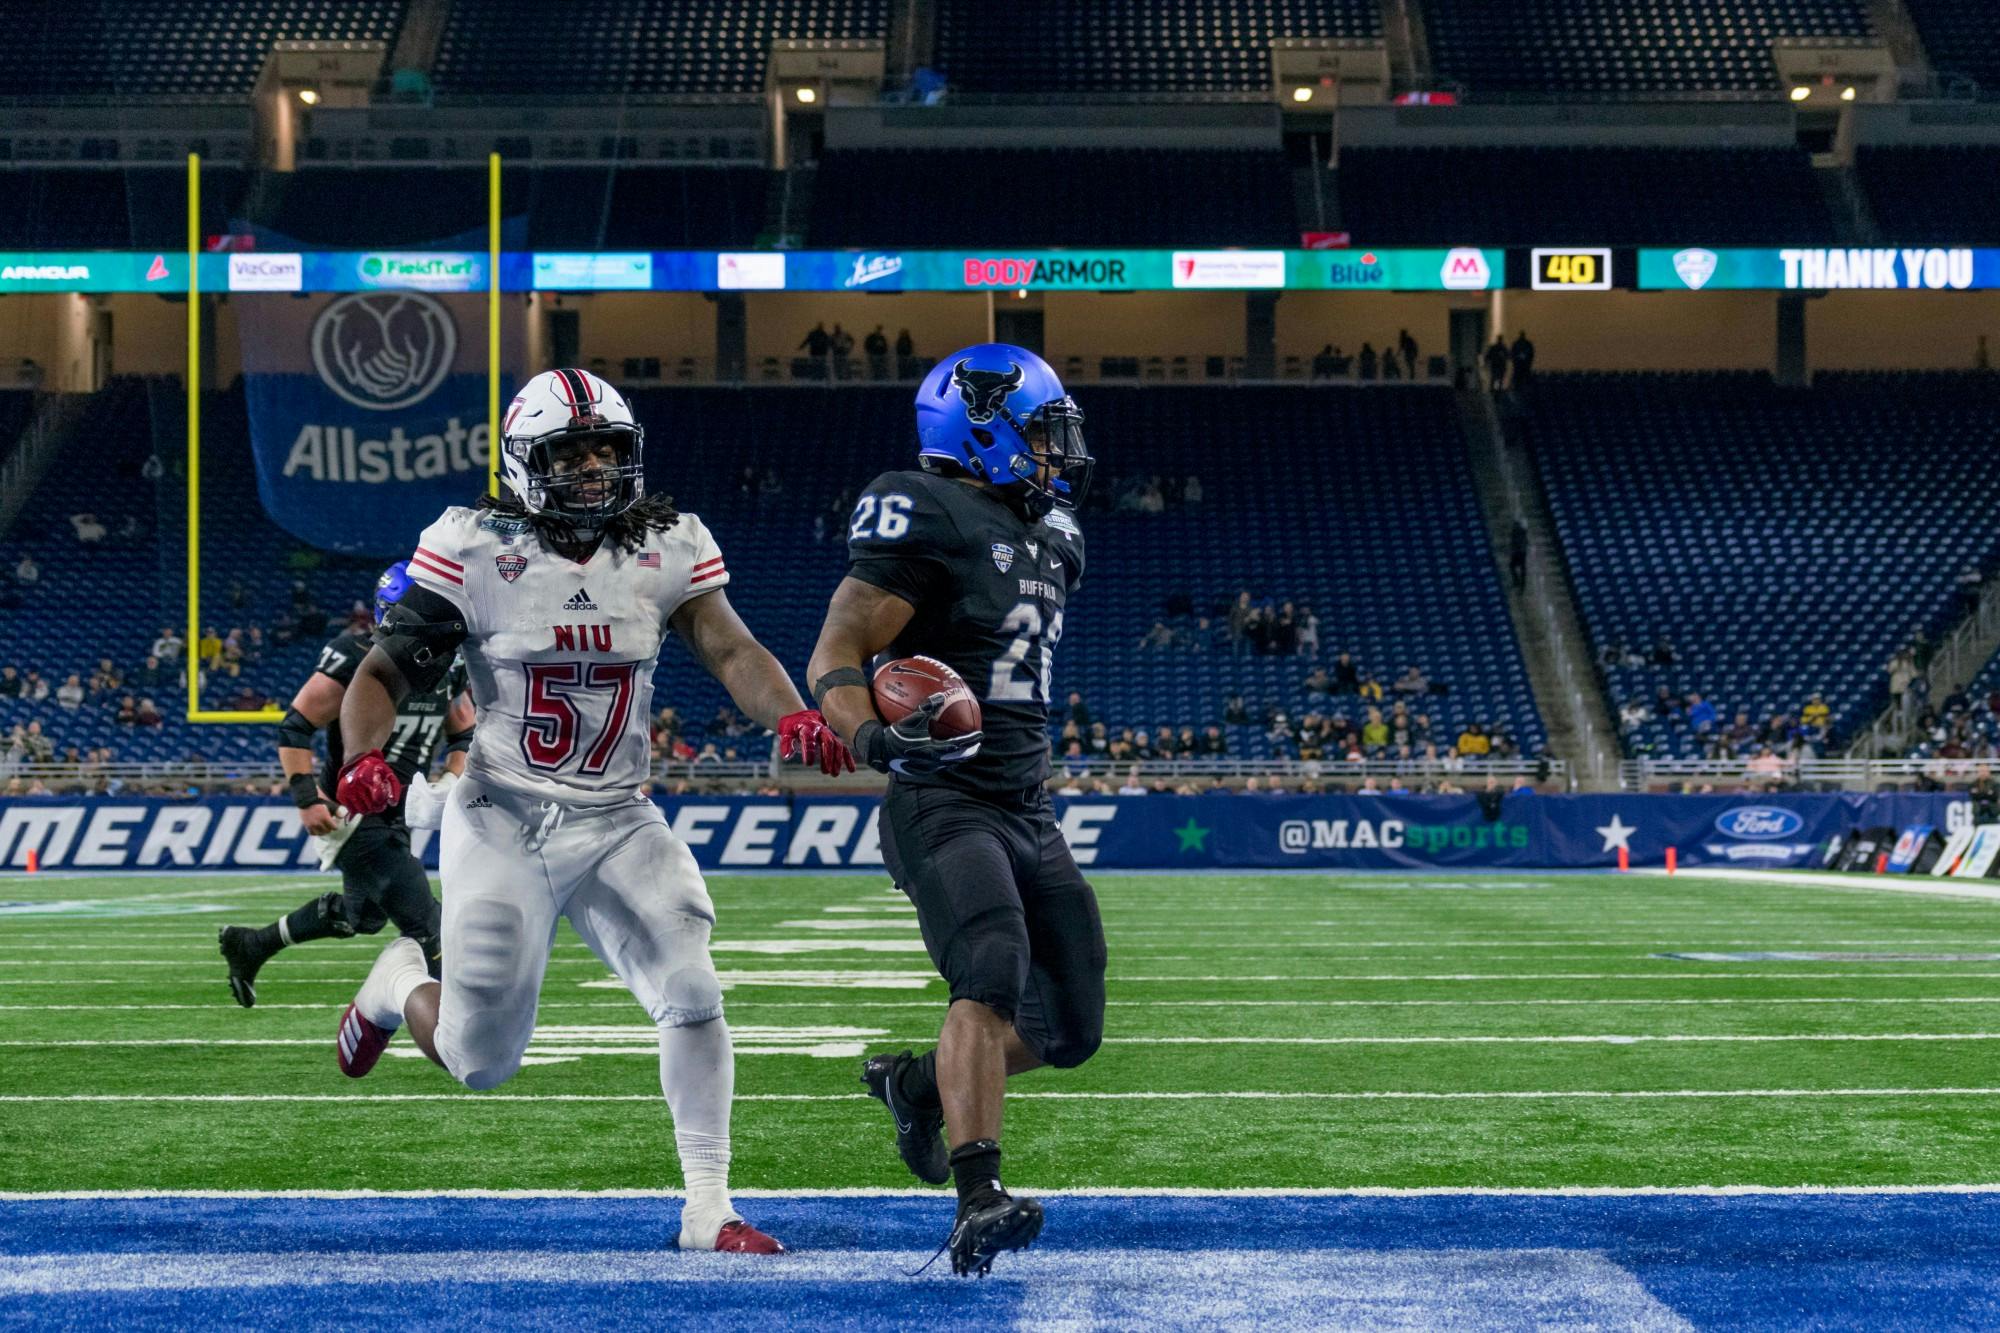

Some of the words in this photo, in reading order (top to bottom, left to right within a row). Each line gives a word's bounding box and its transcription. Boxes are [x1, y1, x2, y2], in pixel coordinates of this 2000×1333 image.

[1, 266, 90, 280] ARMOUR
[234, 260, 296, 276] VizCom
[387, 260, 473, 275] FieldTurf
[1331, 263, 1384, 284] Blue
[1546, 255, 1596, 284] 40
[1779, 249, 1898, 289] THANK
[1900, 249, 1974, 290] YOU
[282, 417, 490, 484] Allstate
[849, 493, 914, 540] 26
[497, 562, 525, 571] MAC
[992, 550, 1014, 563] MAC
[563, 602, 598, 611] adidas
[553, 624, 613, 652] NIU
[318, 645, 347, 674] 77
[519, 661, 641, 777] 57
[384, 714, 446, 765] 77
[1732, 811, 1786, 833] Ford
[1279, 819, 1529, 854] @MACsports
